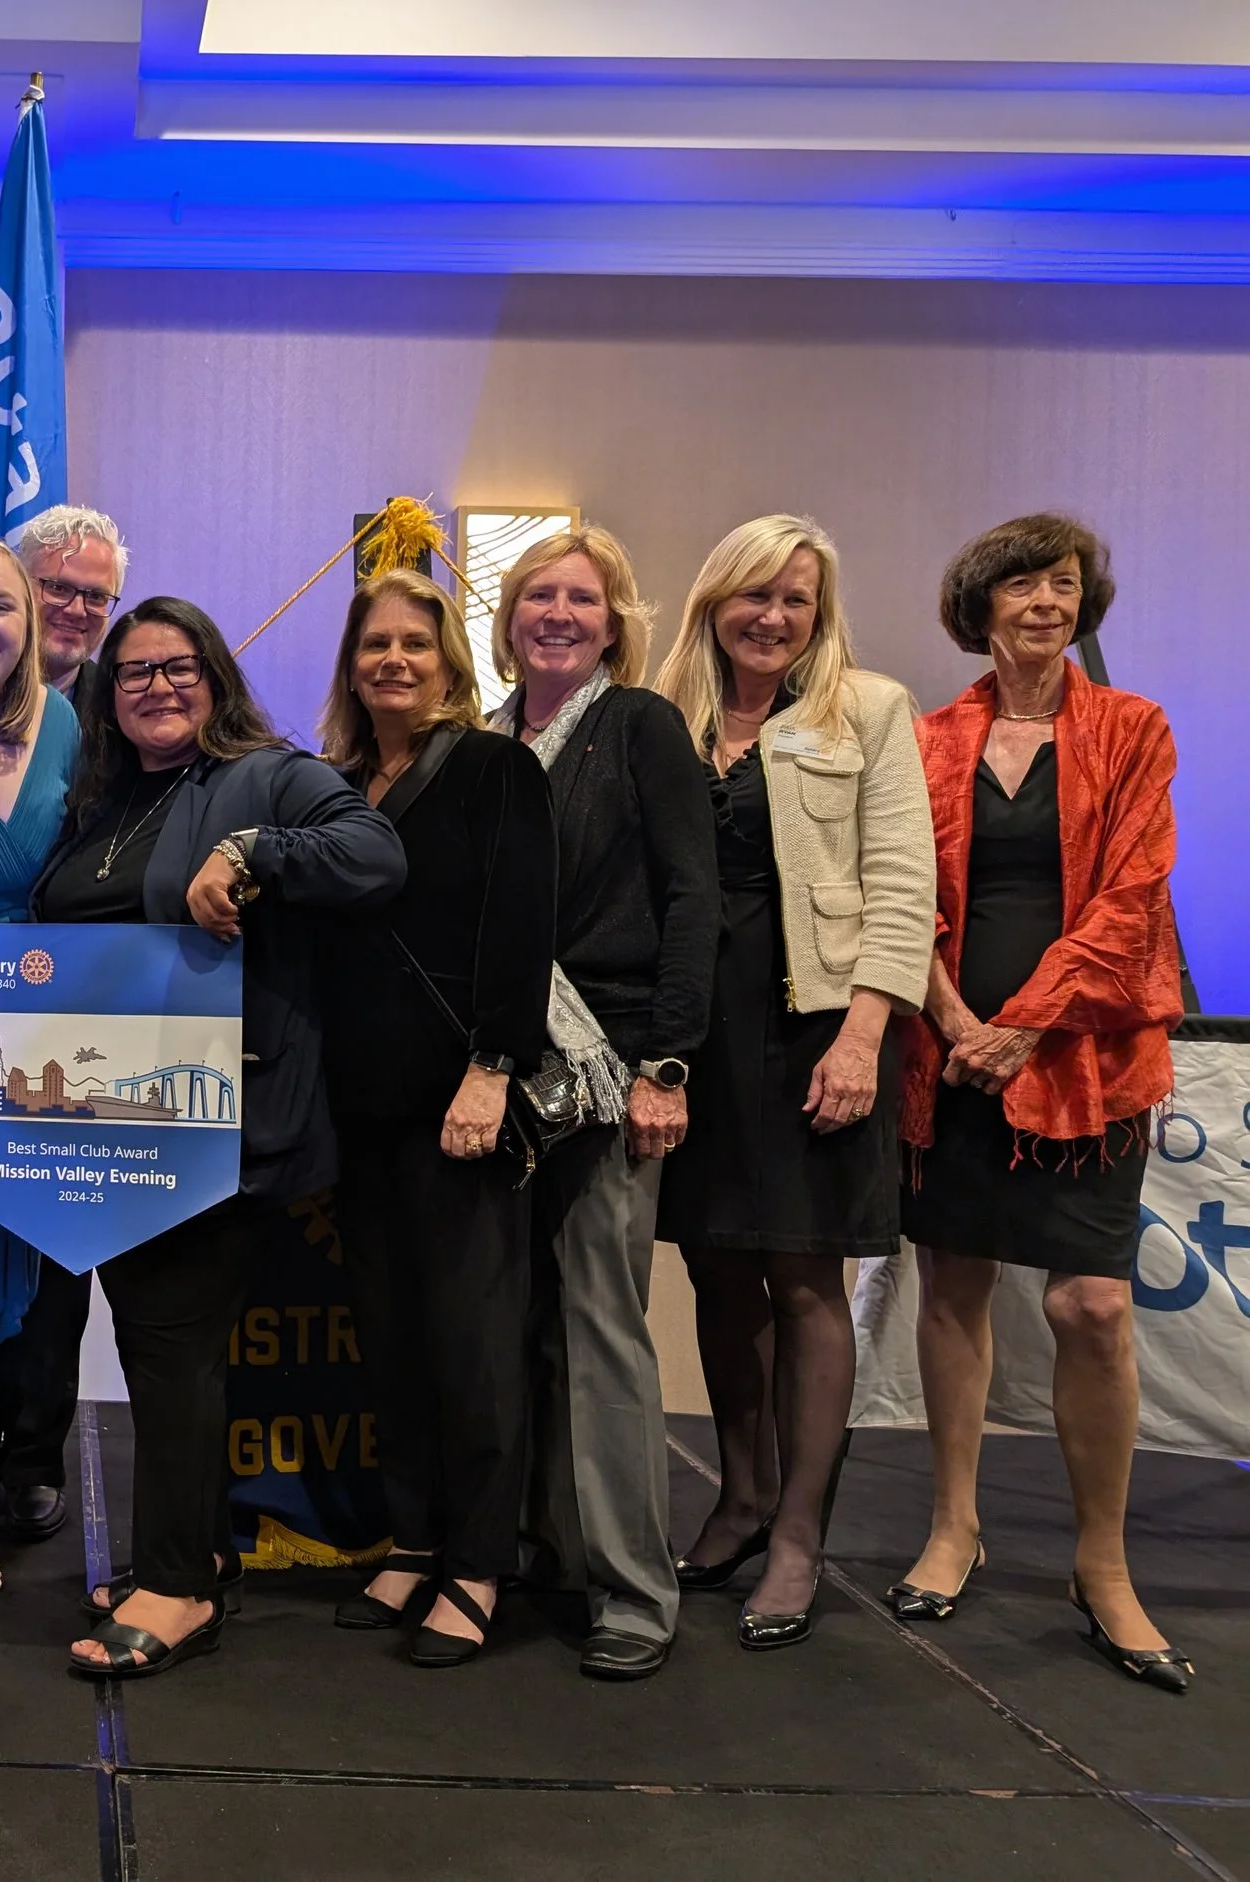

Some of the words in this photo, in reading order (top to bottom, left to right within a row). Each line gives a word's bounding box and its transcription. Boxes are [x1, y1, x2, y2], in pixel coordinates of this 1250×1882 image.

[8, 1142, 36, 1156] Best
[40, 1143, 76, 1157] Small
[80, 1144, 111, 1159] Club
[114, 1147, 158, 1160] Award
[55, 1166, 105, 1187] Valley
[110, 1169, 177, 1190] Evening
[58, 1190, 104, 1203] 2024-25
[229, 1306, 362, 1366] ISTR
[229, 1413, 379, 1476] GOVE
